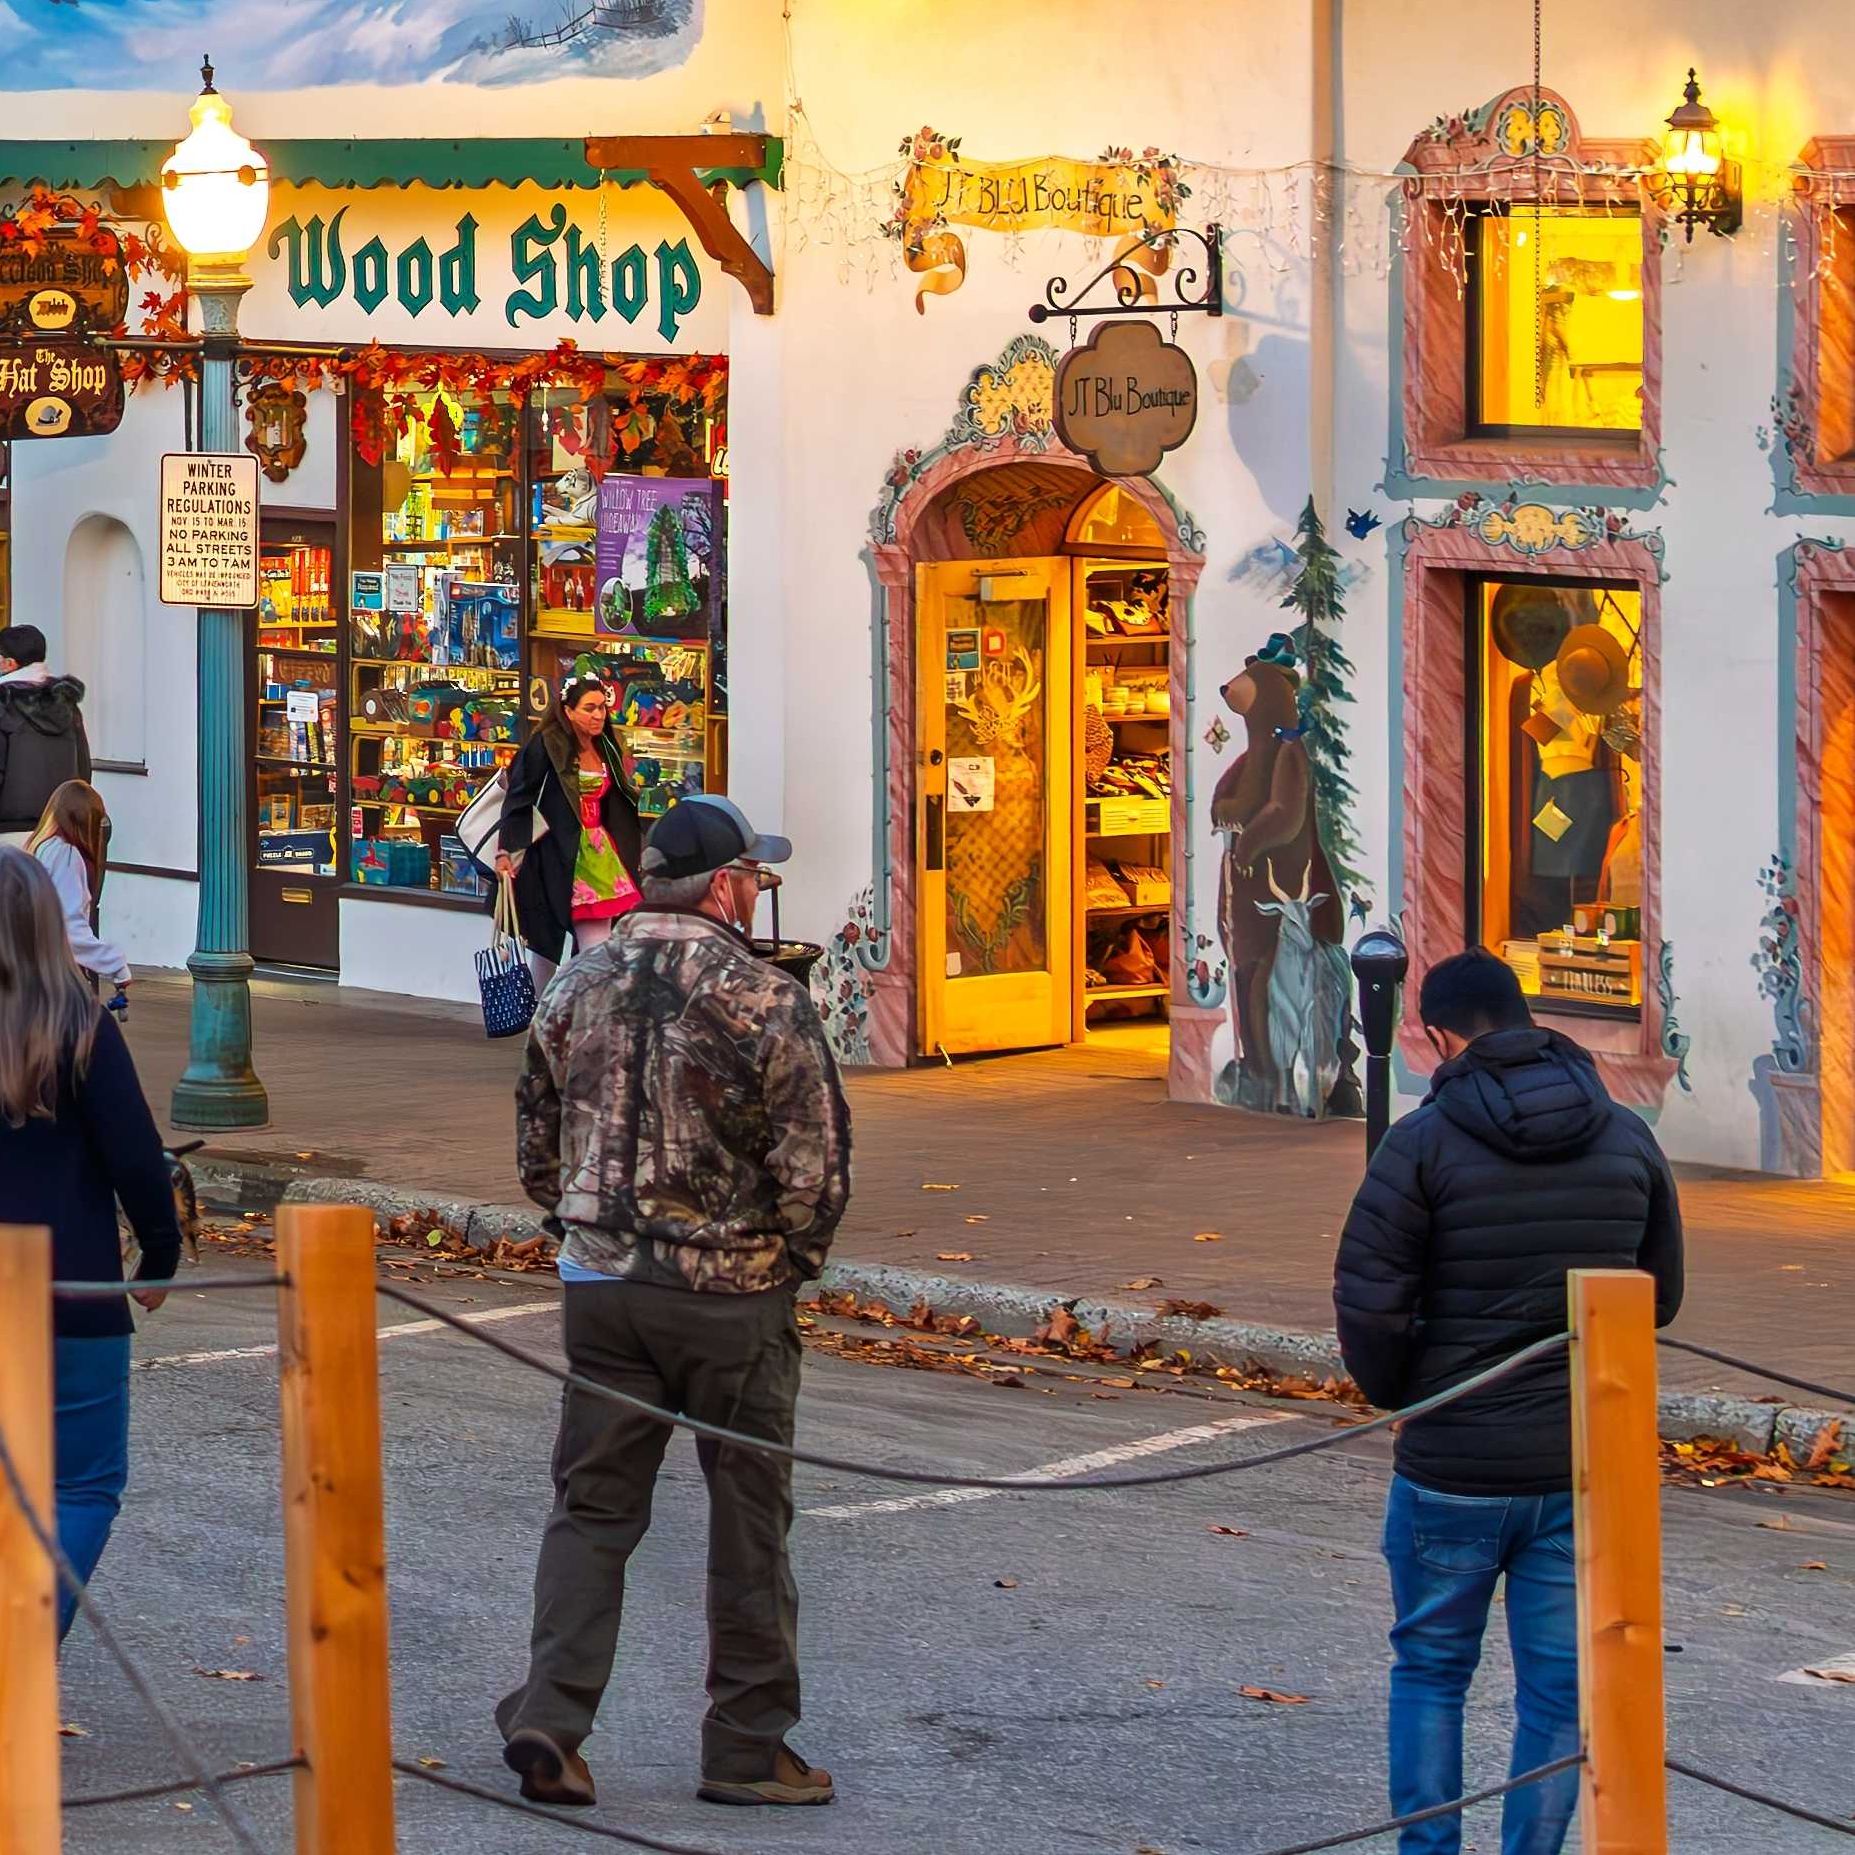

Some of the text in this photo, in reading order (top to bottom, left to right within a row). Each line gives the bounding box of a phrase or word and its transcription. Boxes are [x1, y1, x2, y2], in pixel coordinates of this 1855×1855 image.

[1034, 173, 1143, 233] Boutique
[268, 203, 702, 344] Wood Shop
[35, 348, 55, 365] The
[48, 358, 106, 396] Shop
[1069, 376, 1190, 419] JT Blu Boutique
[187, 463, 232, 479] WINTER
[183, 481, 236, 496] PARKING
[167, 498, 251, 515] REGULATIONS
[601, 487, 659, 511] WILLOW TREE
[171, 516, 188, 526] NOV
[192, 517, 201, 527] 15
[204, 517, 214, 527] TO
[217, 518, 233, 527] MAR
[169, 529, 248, 541] NO PARKING
[166, 543, 252, 555] ALL STREETS
[202, 558, 218, 568] TO
